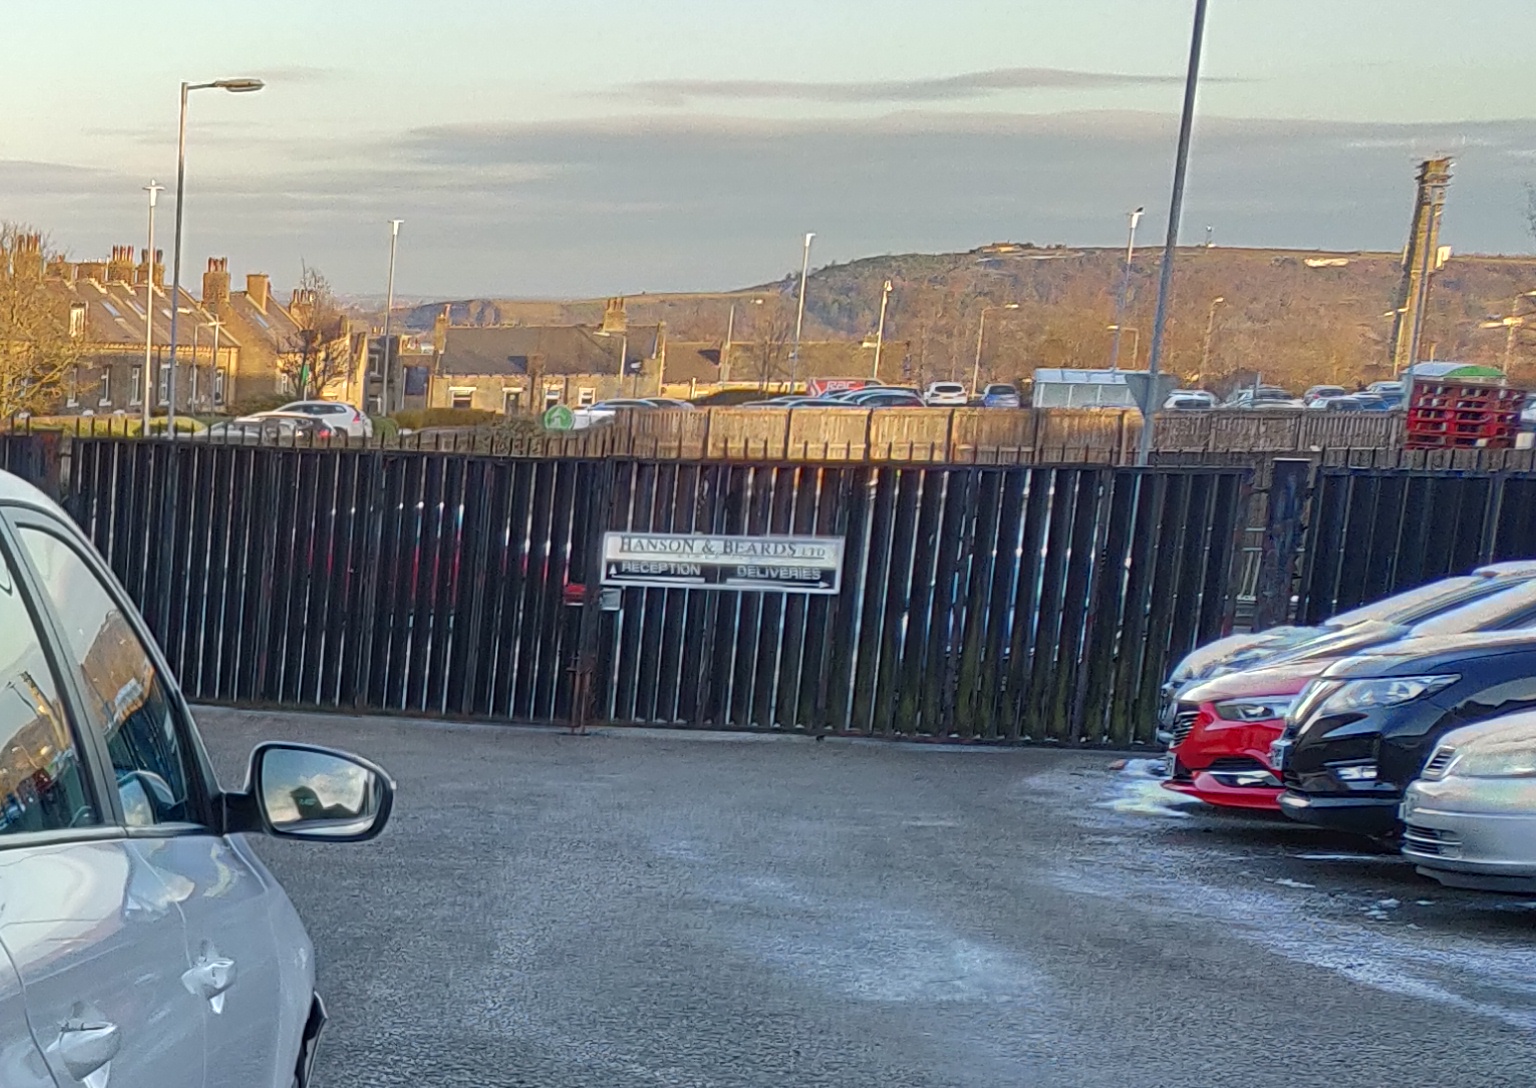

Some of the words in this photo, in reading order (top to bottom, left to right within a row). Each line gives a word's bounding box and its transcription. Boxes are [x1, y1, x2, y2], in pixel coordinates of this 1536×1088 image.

[619, 535, 694, 553] HANSON
[701, 540, 715, 555] &
[723, 541, 796, 557] BEARDS
[621, 561, 702, 576] RECEPTION
[736, 565, 822, 581] DELIVERIES
